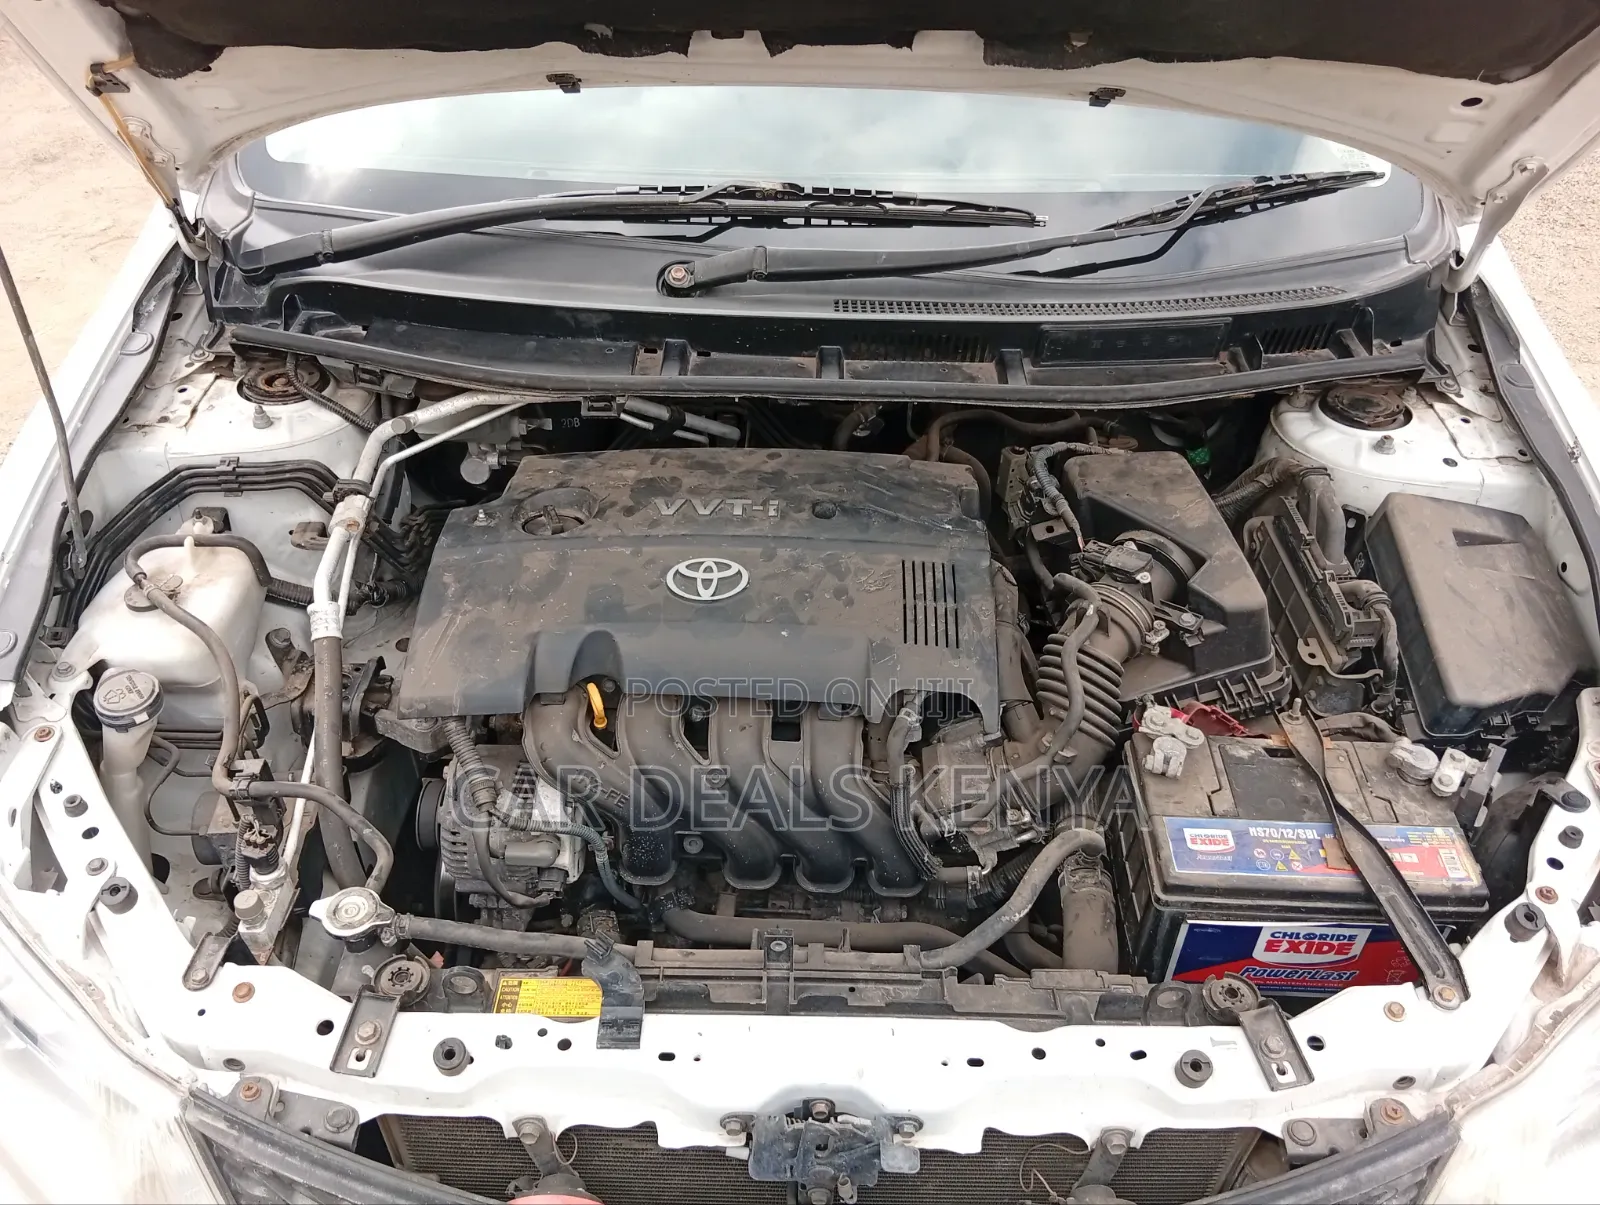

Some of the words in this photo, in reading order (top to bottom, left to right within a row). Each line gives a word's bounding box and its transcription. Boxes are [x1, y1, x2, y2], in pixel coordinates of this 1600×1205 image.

[653, 497, 781, 517] VVT-i
[1189, 837, 1230, 846] EXIDE
[1270, 931, 1358, 942] CHLORIDE
[1263, 939, 1354, 956] EXIDE
